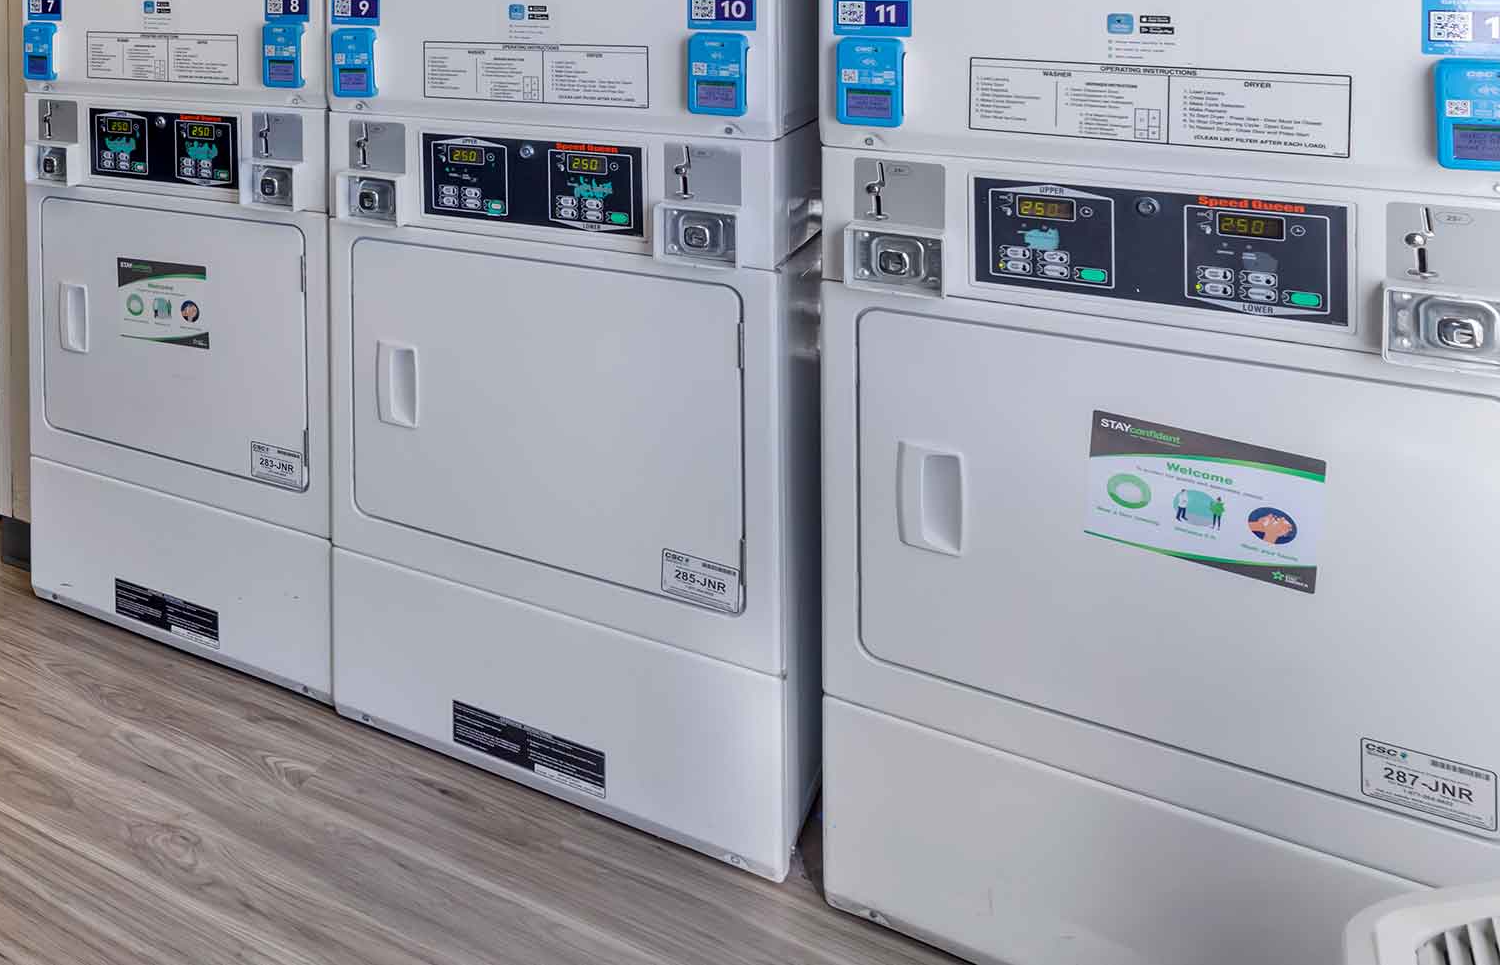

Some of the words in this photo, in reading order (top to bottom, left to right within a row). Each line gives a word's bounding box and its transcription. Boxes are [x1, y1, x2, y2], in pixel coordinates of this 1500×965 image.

[47, 0, 55, 12] 7
[359, 0, 369, 15] 9
[721, 0, 746, 18] 10
[875, 4, 896, 23] 11
[1485, 16, 1500, 39] 1
[1100, 66, 1141, 74] OPERATING
[1142, 68, 1197, 76] INSTRUCTIONS
[1244, 81, 1272, 89] DRYER
[111, 122, 128, 131] 250
[192, 126, 210, 136] 250
[452, 150, 477, 162] 250
[572, 158, 598, 171] 250
[1039, 186, 1065, 195] UPPER
[1020, 200, 1061, 217] 250
[1197, 195, 1249, 209] Speed
[1251, 199, 1306, 213] Queen
[1220, 218, 1265, 235] 250
[1242, 304, 1274, 315] LOWER
[260, 457, 294, 473] 283-JNR
[1166, 461, 1233, 485] Welcome
[674, 569, 727, 593] 285-JNR
[1365, 743, 1398, 757] CSC
[1383, 767, 1474, 803] 287-JNR
